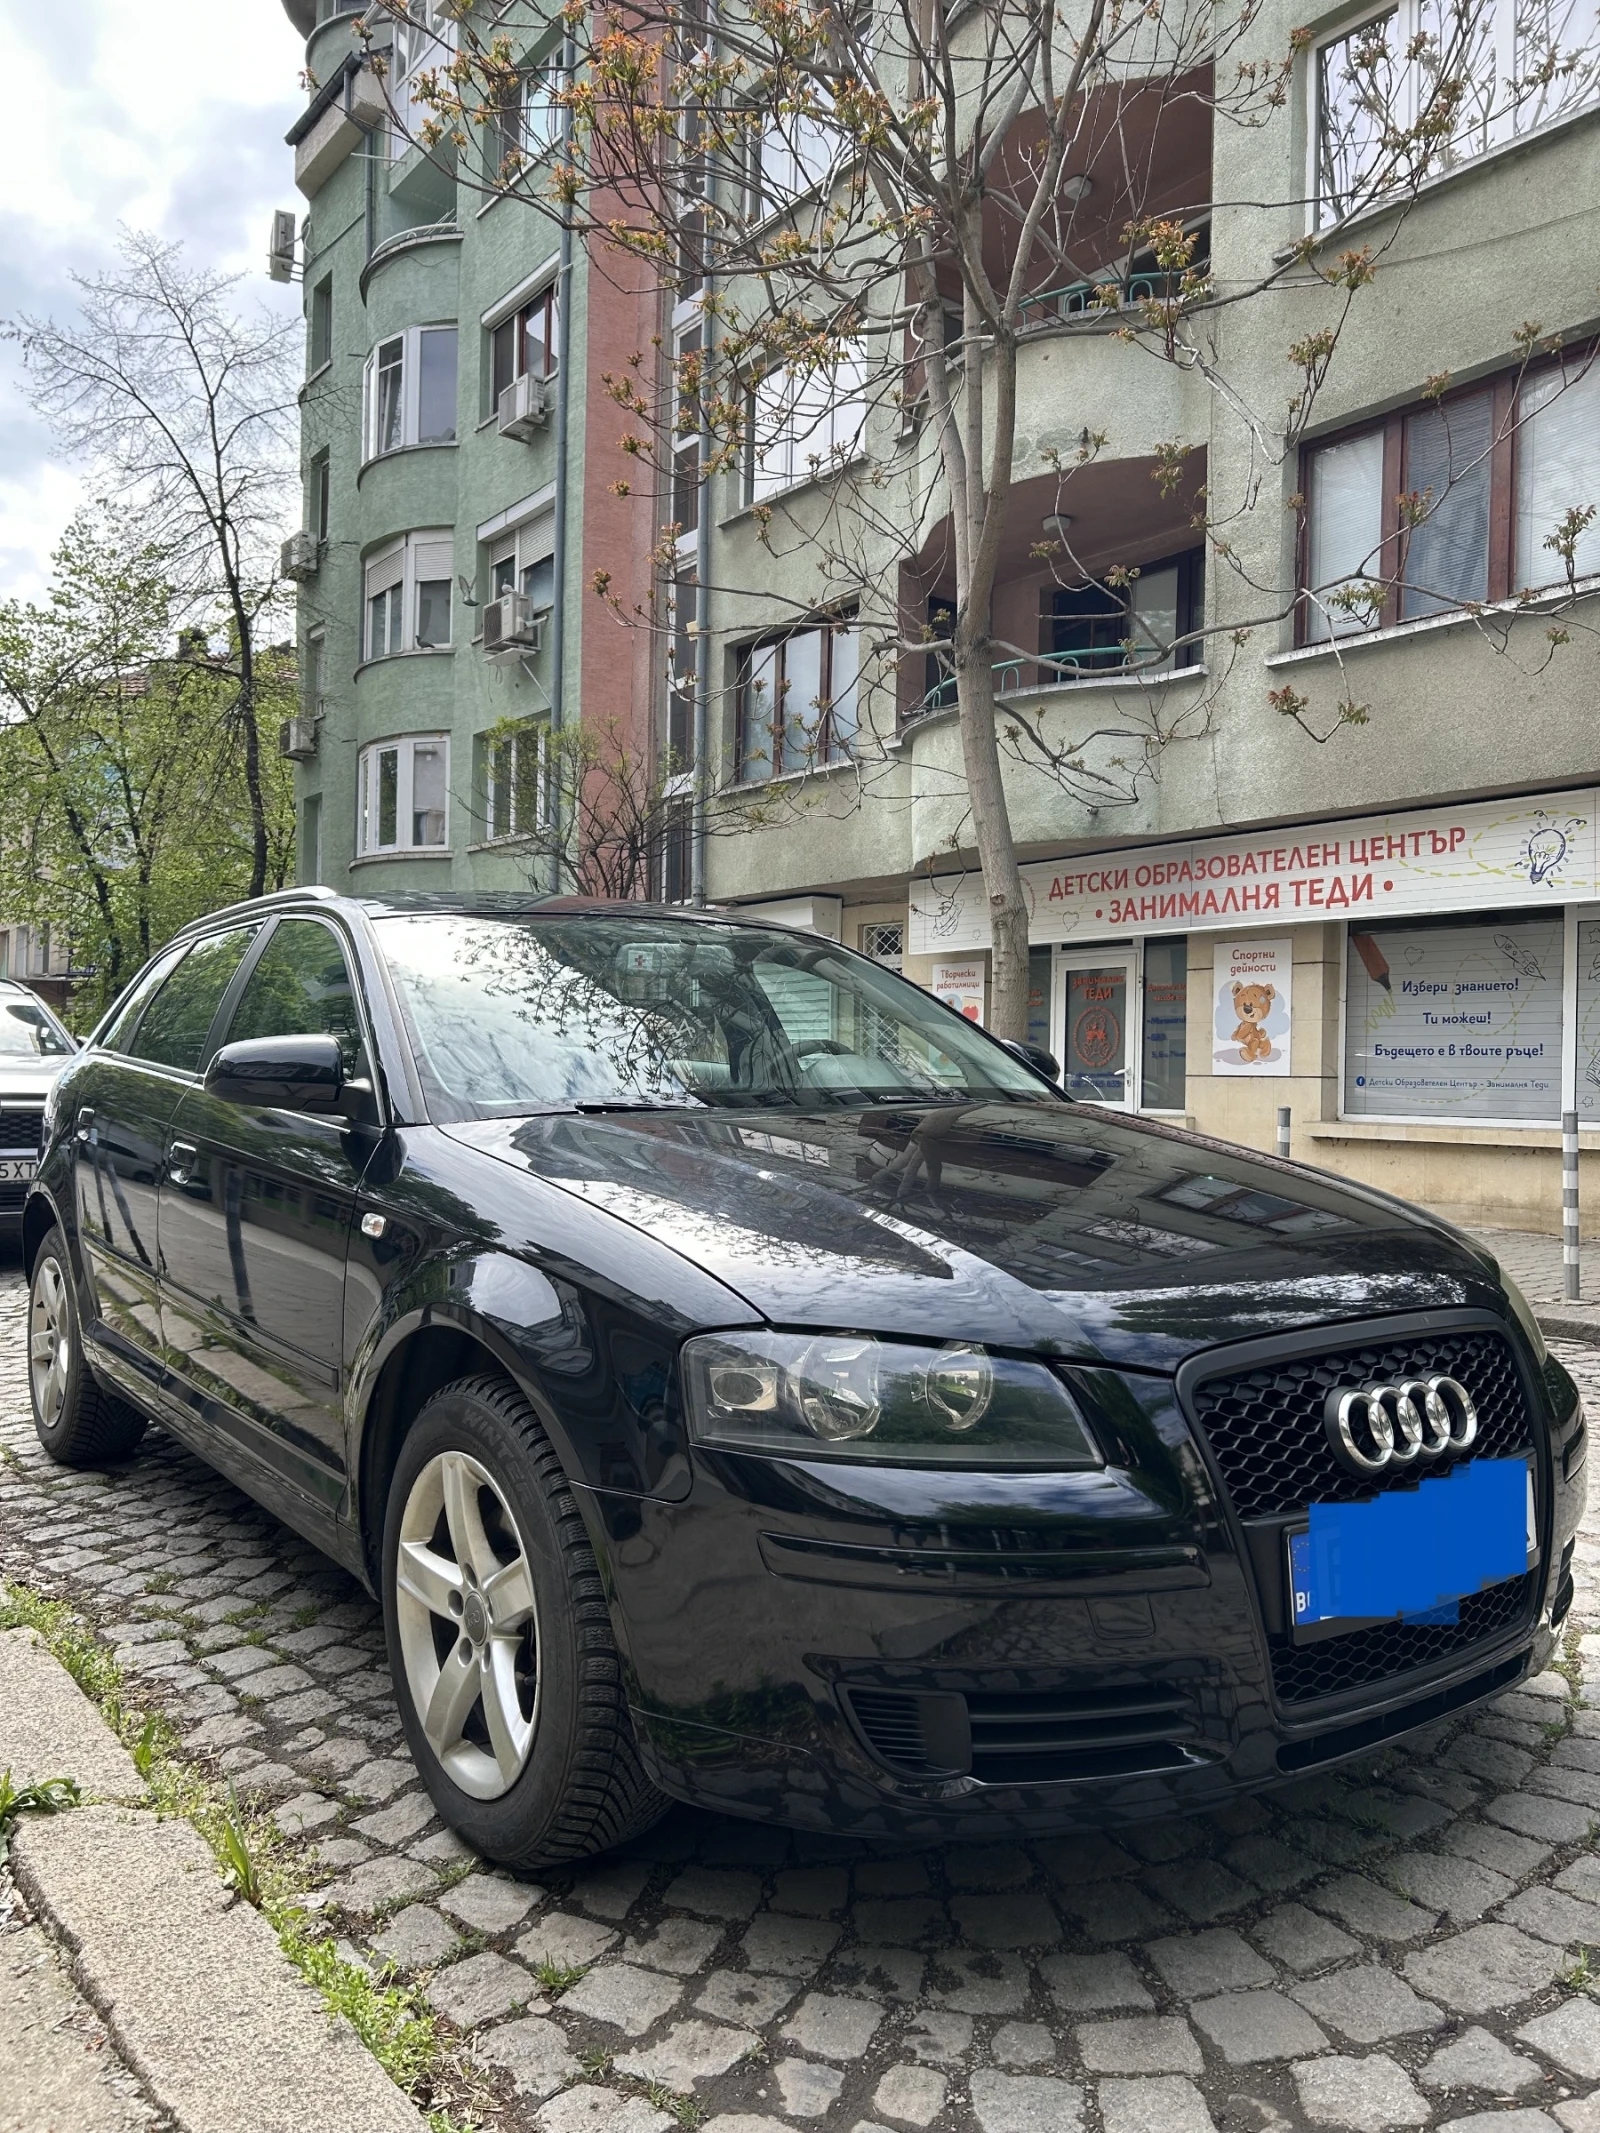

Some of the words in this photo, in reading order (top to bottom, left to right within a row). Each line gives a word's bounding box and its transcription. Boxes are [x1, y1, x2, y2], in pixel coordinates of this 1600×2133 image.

[1049, 868, 1128, 901] ДЕТСКИ
[1135, 842, 1340, 886] ОБРАЗОВАТЕЛЕН
[1349, 827, 1466, 867] ЦЕНТЪР
[1108, 883, 1280, 924] ЗАНИМАЛНЯ
[1289, 873, 1374, 909] ТЕДИ
[1232, 949, 1275, 962] Спортни
[940, 968, 976, 980] Творчески
[1230, 963, 1276, 976] дейности
[936, 980, 980, 992] работилници
[1402, 980, 1448, 996] Избери
[1455, 978, 1519, 995] знанието!
[1423, 1012, 1438, 1024] Ти
[1442, 1011, 1491, 1024] можеш!
[1375, 1043, 1435, 1059] Бъдещето
[1438, 1047, 1445, 1056] е
[1448, 1043, 1456, 1056] в
[1459, 1043, 1502, 1056] твоите
[1506, 1043, 1544, 1060] ръце!
[1369, 1078, 1393, 1087] Детски
[1395, 1077, 1448, 1088] Образователен
[1450, 1079, 1477, 1088] Център
[1486, 1079, 1528, 1088] Занималня
[1531, 1080, 1549, 1090] Теди
[13, 1162, 36, 1178] XT
[461, 1408, 534, 1508] WINTER
